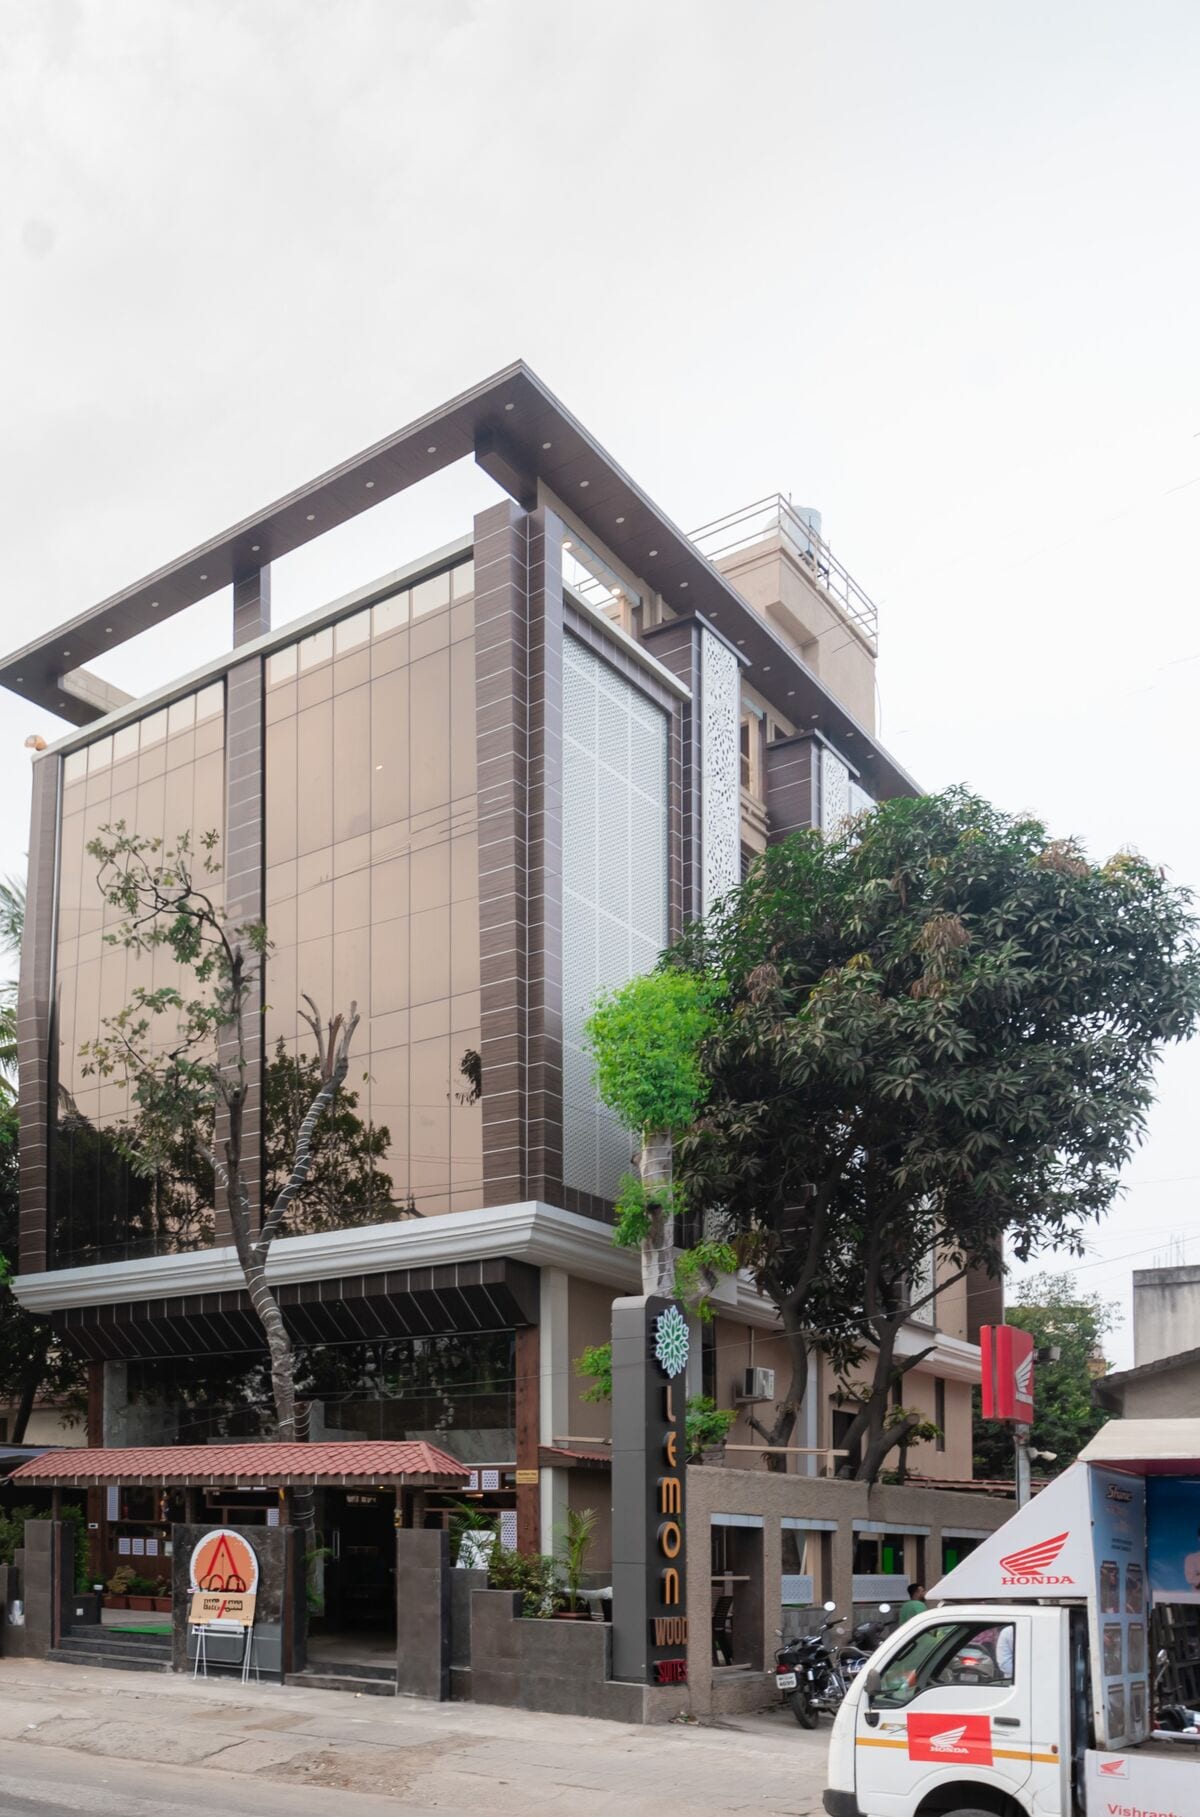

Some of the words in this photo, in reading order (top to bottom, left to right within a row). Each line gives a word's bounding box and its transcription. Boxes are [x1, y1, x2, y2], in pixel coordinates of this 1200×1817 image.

[1001, 1575, 1075, 1585] HONDA
[655, 1618, 688, 1647] WOOD
[929, 1746, 969, 1754] HONDA
